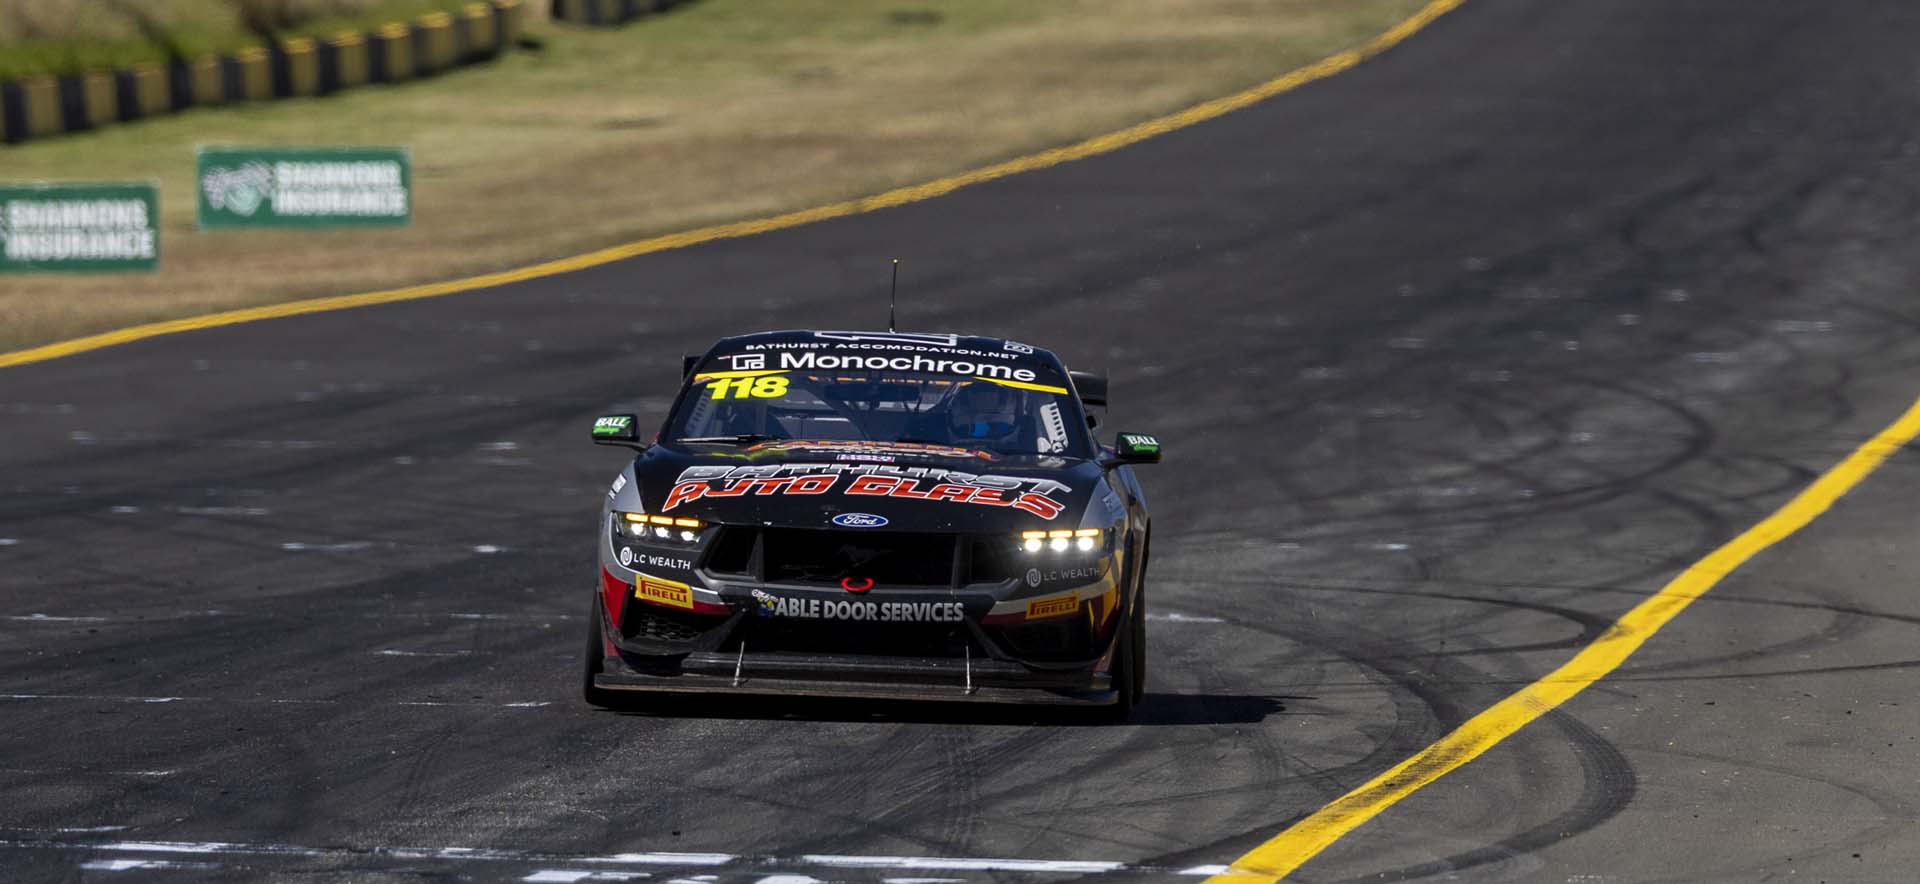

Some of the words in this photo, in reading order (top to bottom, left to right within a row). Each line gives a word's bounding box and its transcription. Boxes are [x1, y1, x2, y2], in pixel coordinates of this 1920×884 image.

[272, 190, 407, 215] INSURANCE
[5, 232, 154, 260] INSURANCE
[745, 342, 830, 351] BATHURST
[835, 342, 1019, 360] ACCOMODATION.NET
[780, 352, 1036, 382] Monochrome
[706, 376, 790, 400] 118
[594, 416, 629, 427] BALL
[1125, 435, 1160, 446] BALL
[675, 463, 1073, 495] BATHURST
[661, 475, 840, 512] AUTO
[844, 475, 1066, 520] GLASS
[843, 513, 878, 525] Ford
[633, 553, 646, 563] LC
[649, 555, 691, 570] WEALTH
[1043, 569, 1057, 581] LC
[1061, 567, 1100, 579] WEALTH
[640, 580, 688, 603] PIRELLI
[774, 597, 820, 618] ABLE
[823, 600, 878, 621] DOOR
[880, 602, 965, 622] SERVICES
[1029, 595, 1077, 616] PIRELLI
